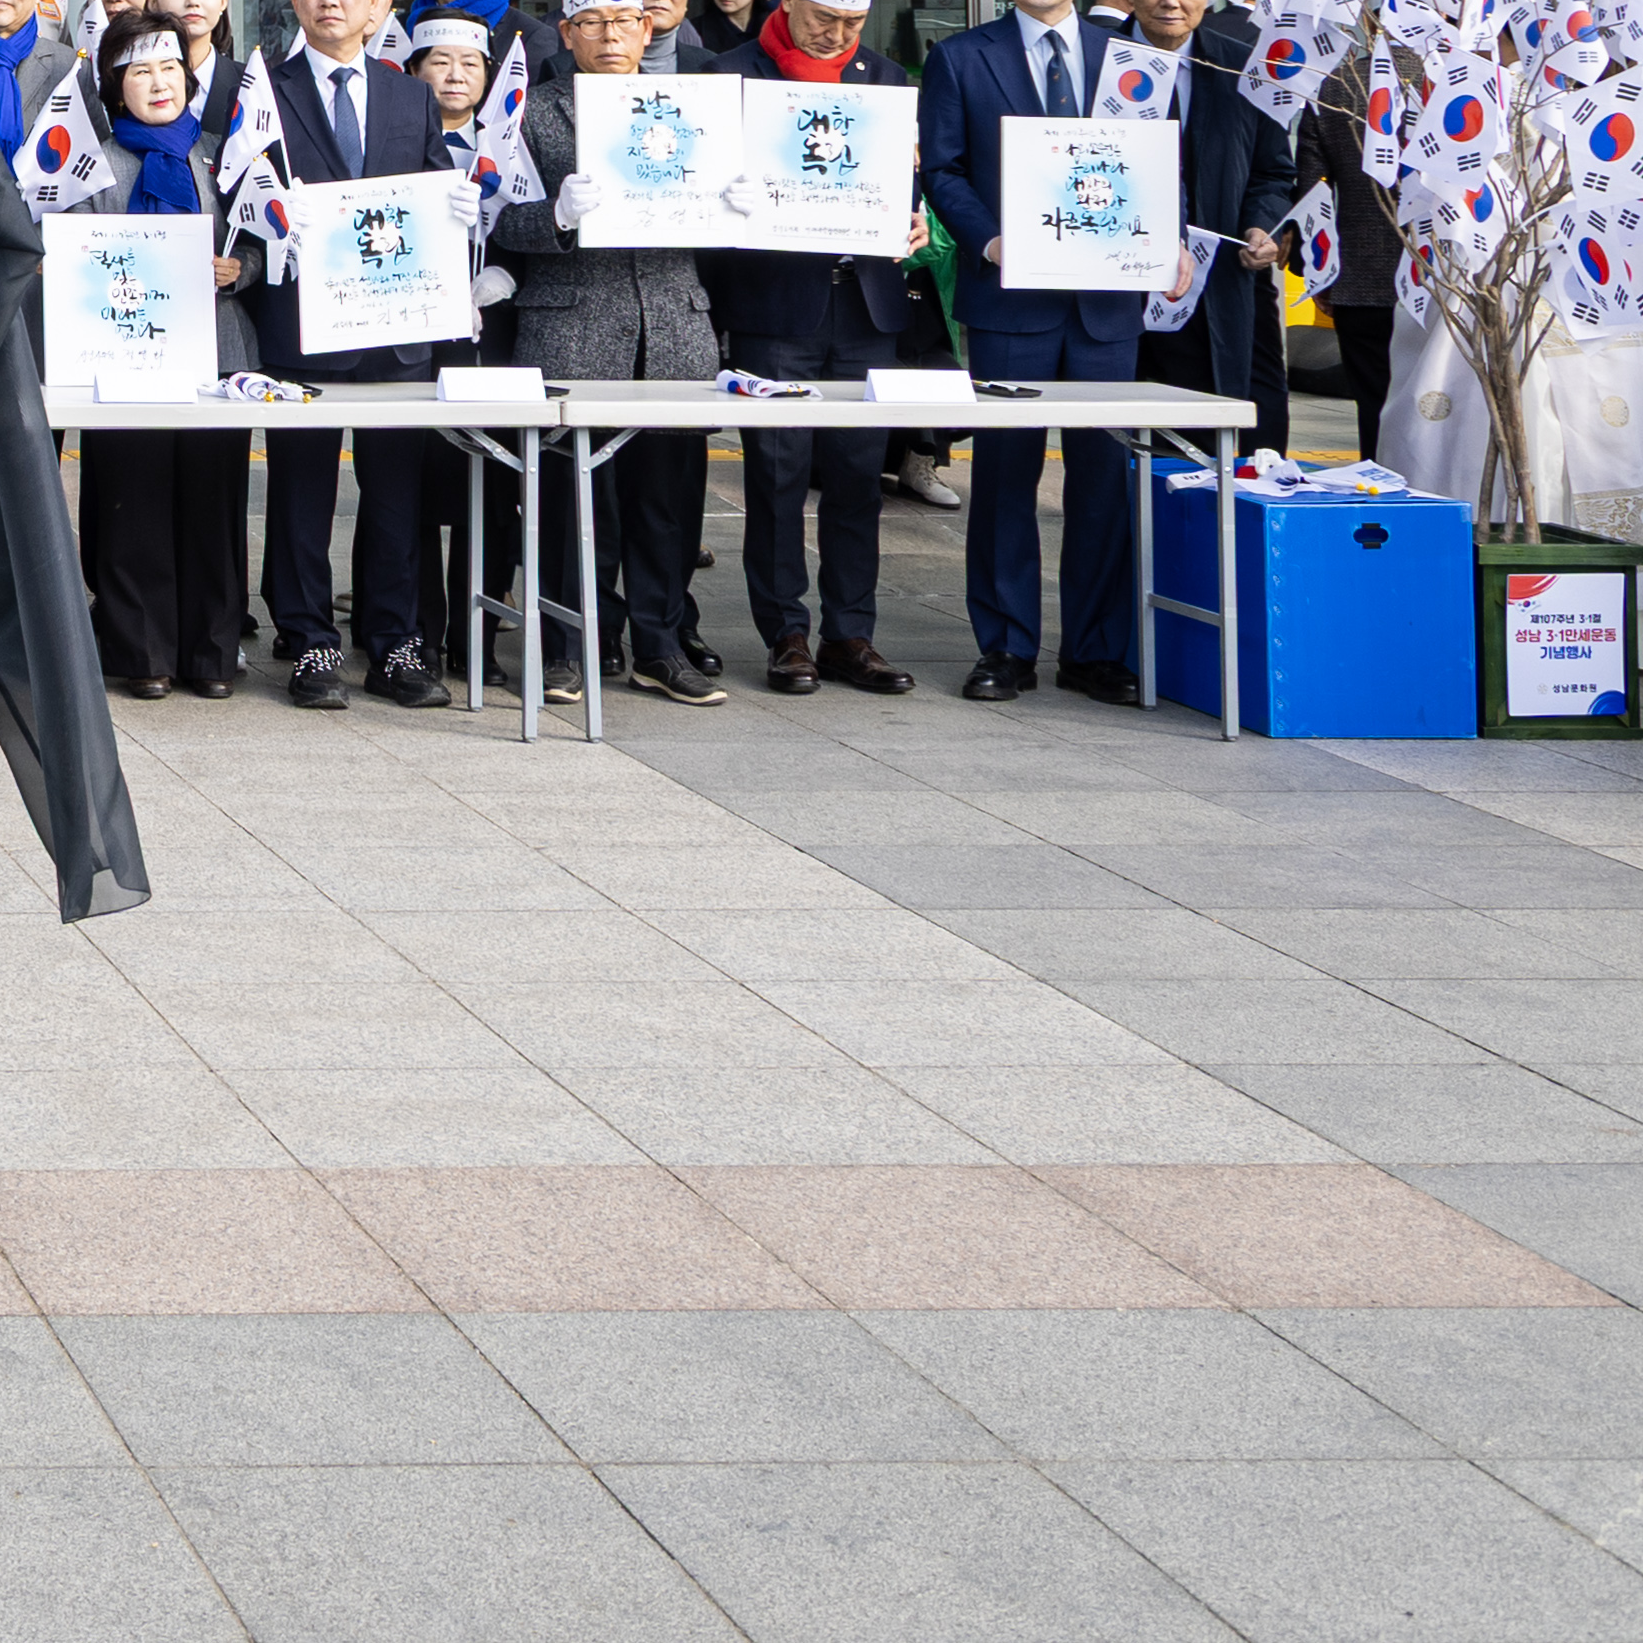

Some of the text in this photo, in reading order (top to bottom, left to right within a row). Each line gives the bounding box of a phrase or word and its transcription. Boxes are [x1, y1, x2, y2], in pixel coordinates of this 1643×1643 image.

[630, 89, 683, 121] 그날의
[796, 104, 856, 137] 대한
[800, 132, 862, 177] 독립
[353, 202, 412, 232] 대한
[356, 231, 414, 270] 독립
[1530, 614, 1575, 624] 제107주년
[1515, 629, 1542, 643] 성남
[1540, 646, 1592, 660] 기념행사
[1552, 683, 1597, 693] 성남문화원
